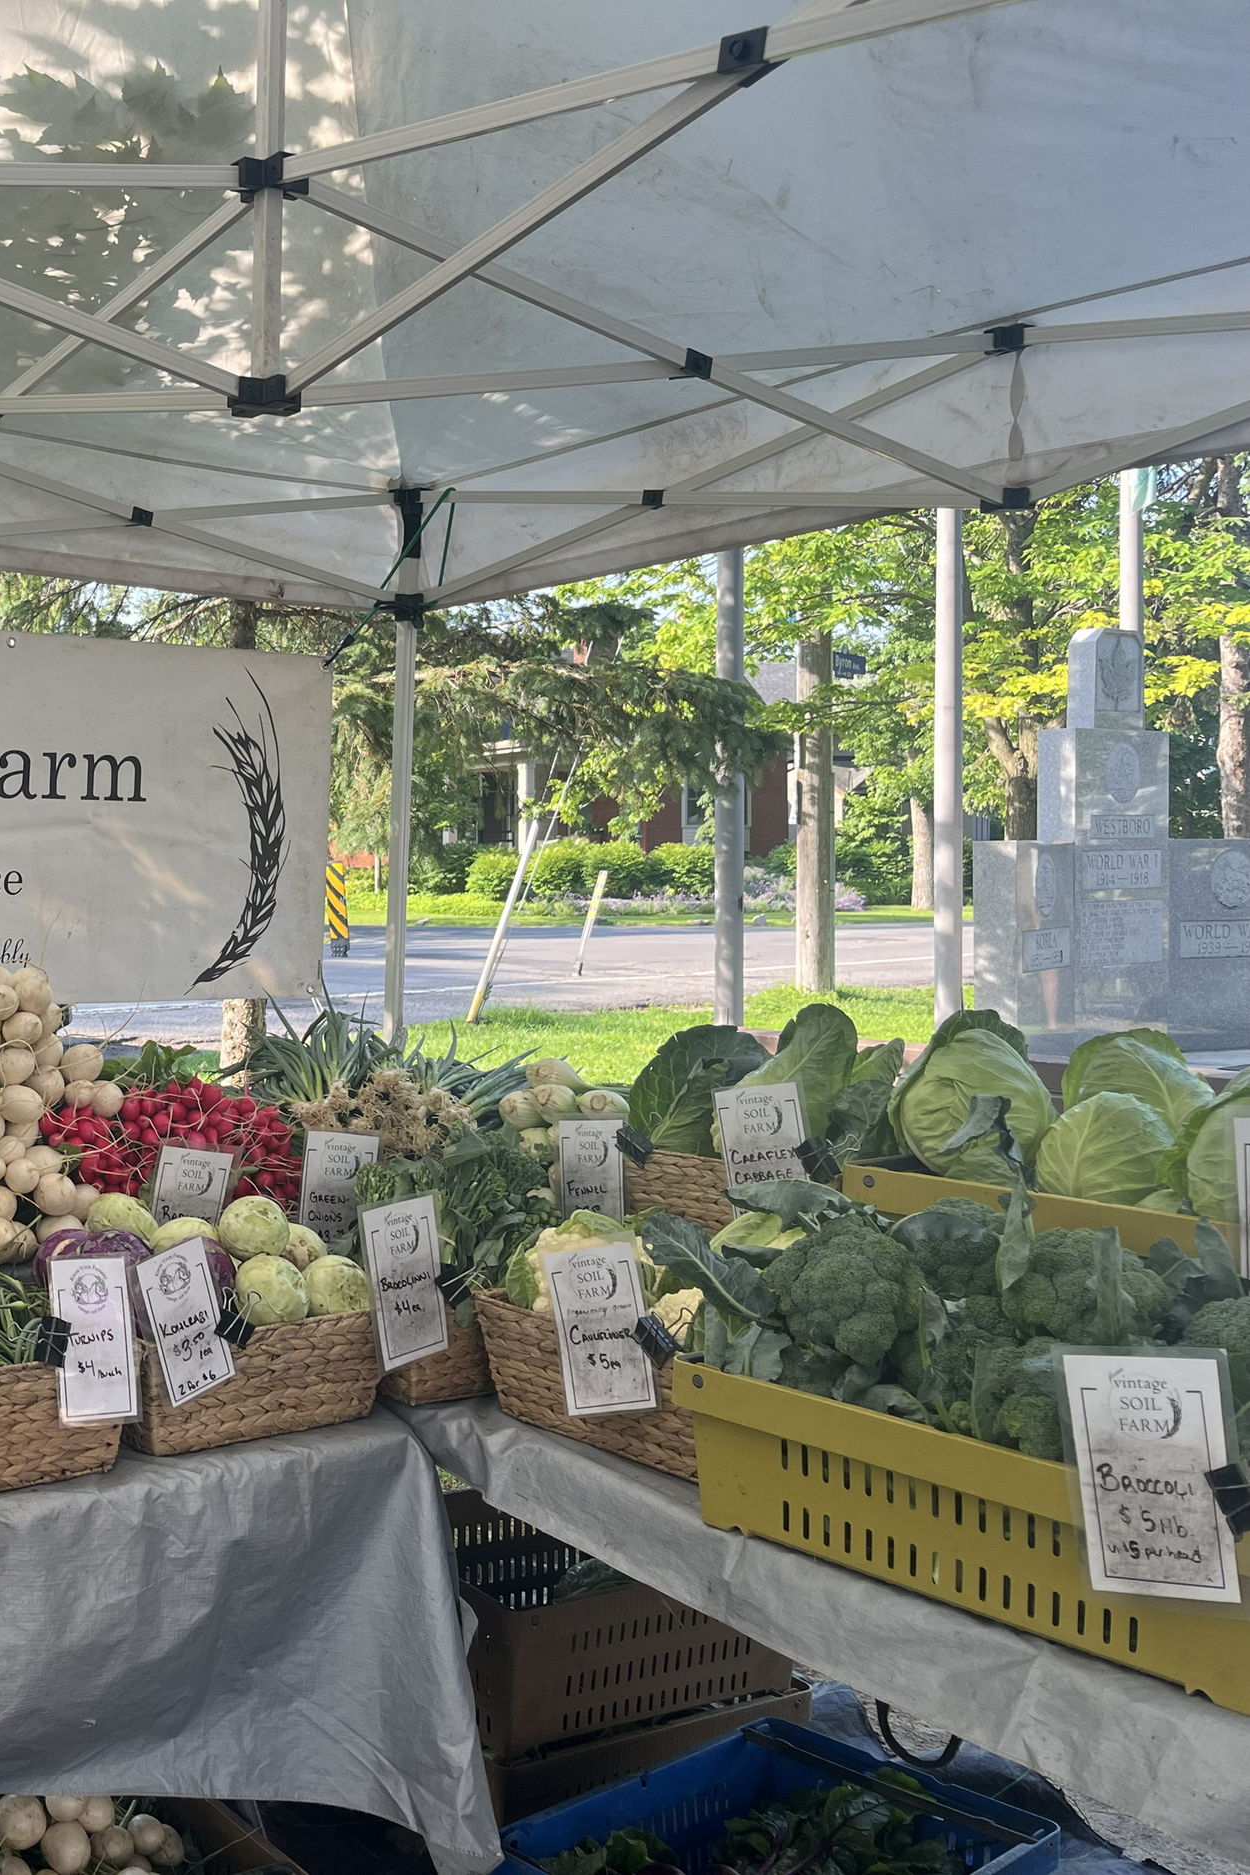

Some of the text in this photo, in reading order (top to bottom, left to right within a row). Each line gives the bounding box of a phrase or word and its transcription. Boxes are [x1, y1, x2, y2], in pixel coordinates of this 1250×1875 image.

[835, 655, 852, 671] Byron
[1095, 819, 1150, 835] WESTBORO
[1087, 854, 1158, 871] WORLD WAR I
[1183, 924, 1230, 939] WORLD
[739, 1095, 773, 1106] vintage
[744, 1108, 770, 1119] SOIL
[744, 1122, 777, 1134] FARM
[577, 1130, 603, 1140] vintage
[327, 1144, 357, 1154] vintage
[579, 1142, 599, 1150] SOIL
[328, 1154, 351, 1164] SOIL
[578, 1155, 601, 1163] FARM
[731, 1147, 797, 1165] CARAFLEX
[182, 1158, 211, 1169] vintage
[182, 1169, 204, 1180] SOIL
[324, 1167, 353, 1176] FARM
[735, 1168, 793, 1185] CABBAGE
[177, 1182, 205, 1192] FARM
[566, 1180, 607, 1196] FENNEL
[308, 1210, 343, 1223] ONIONS
[386, 1214, 413, 1227] vintage
[390, 1230, 411, 1241] SOIL
[390, 1241, 415, 1256] FARM
[571, 1257, 607, 1269] vintage
[577, 1272, 604, 1284] SOIL
[578, 1286, 611, 1299] FARM
[159, 1310, 209, 1338] KOHLRABI
[69, 1329, 114, 1347] TURNIPS
[1113, 1377, 1168, 1394] vintage
[1120, 1397, 1162, 1411] SOIL
[1119, 1418, 1171, 1433] FARM
[1096, 1462, 1193, 1497] BROCCOLI
